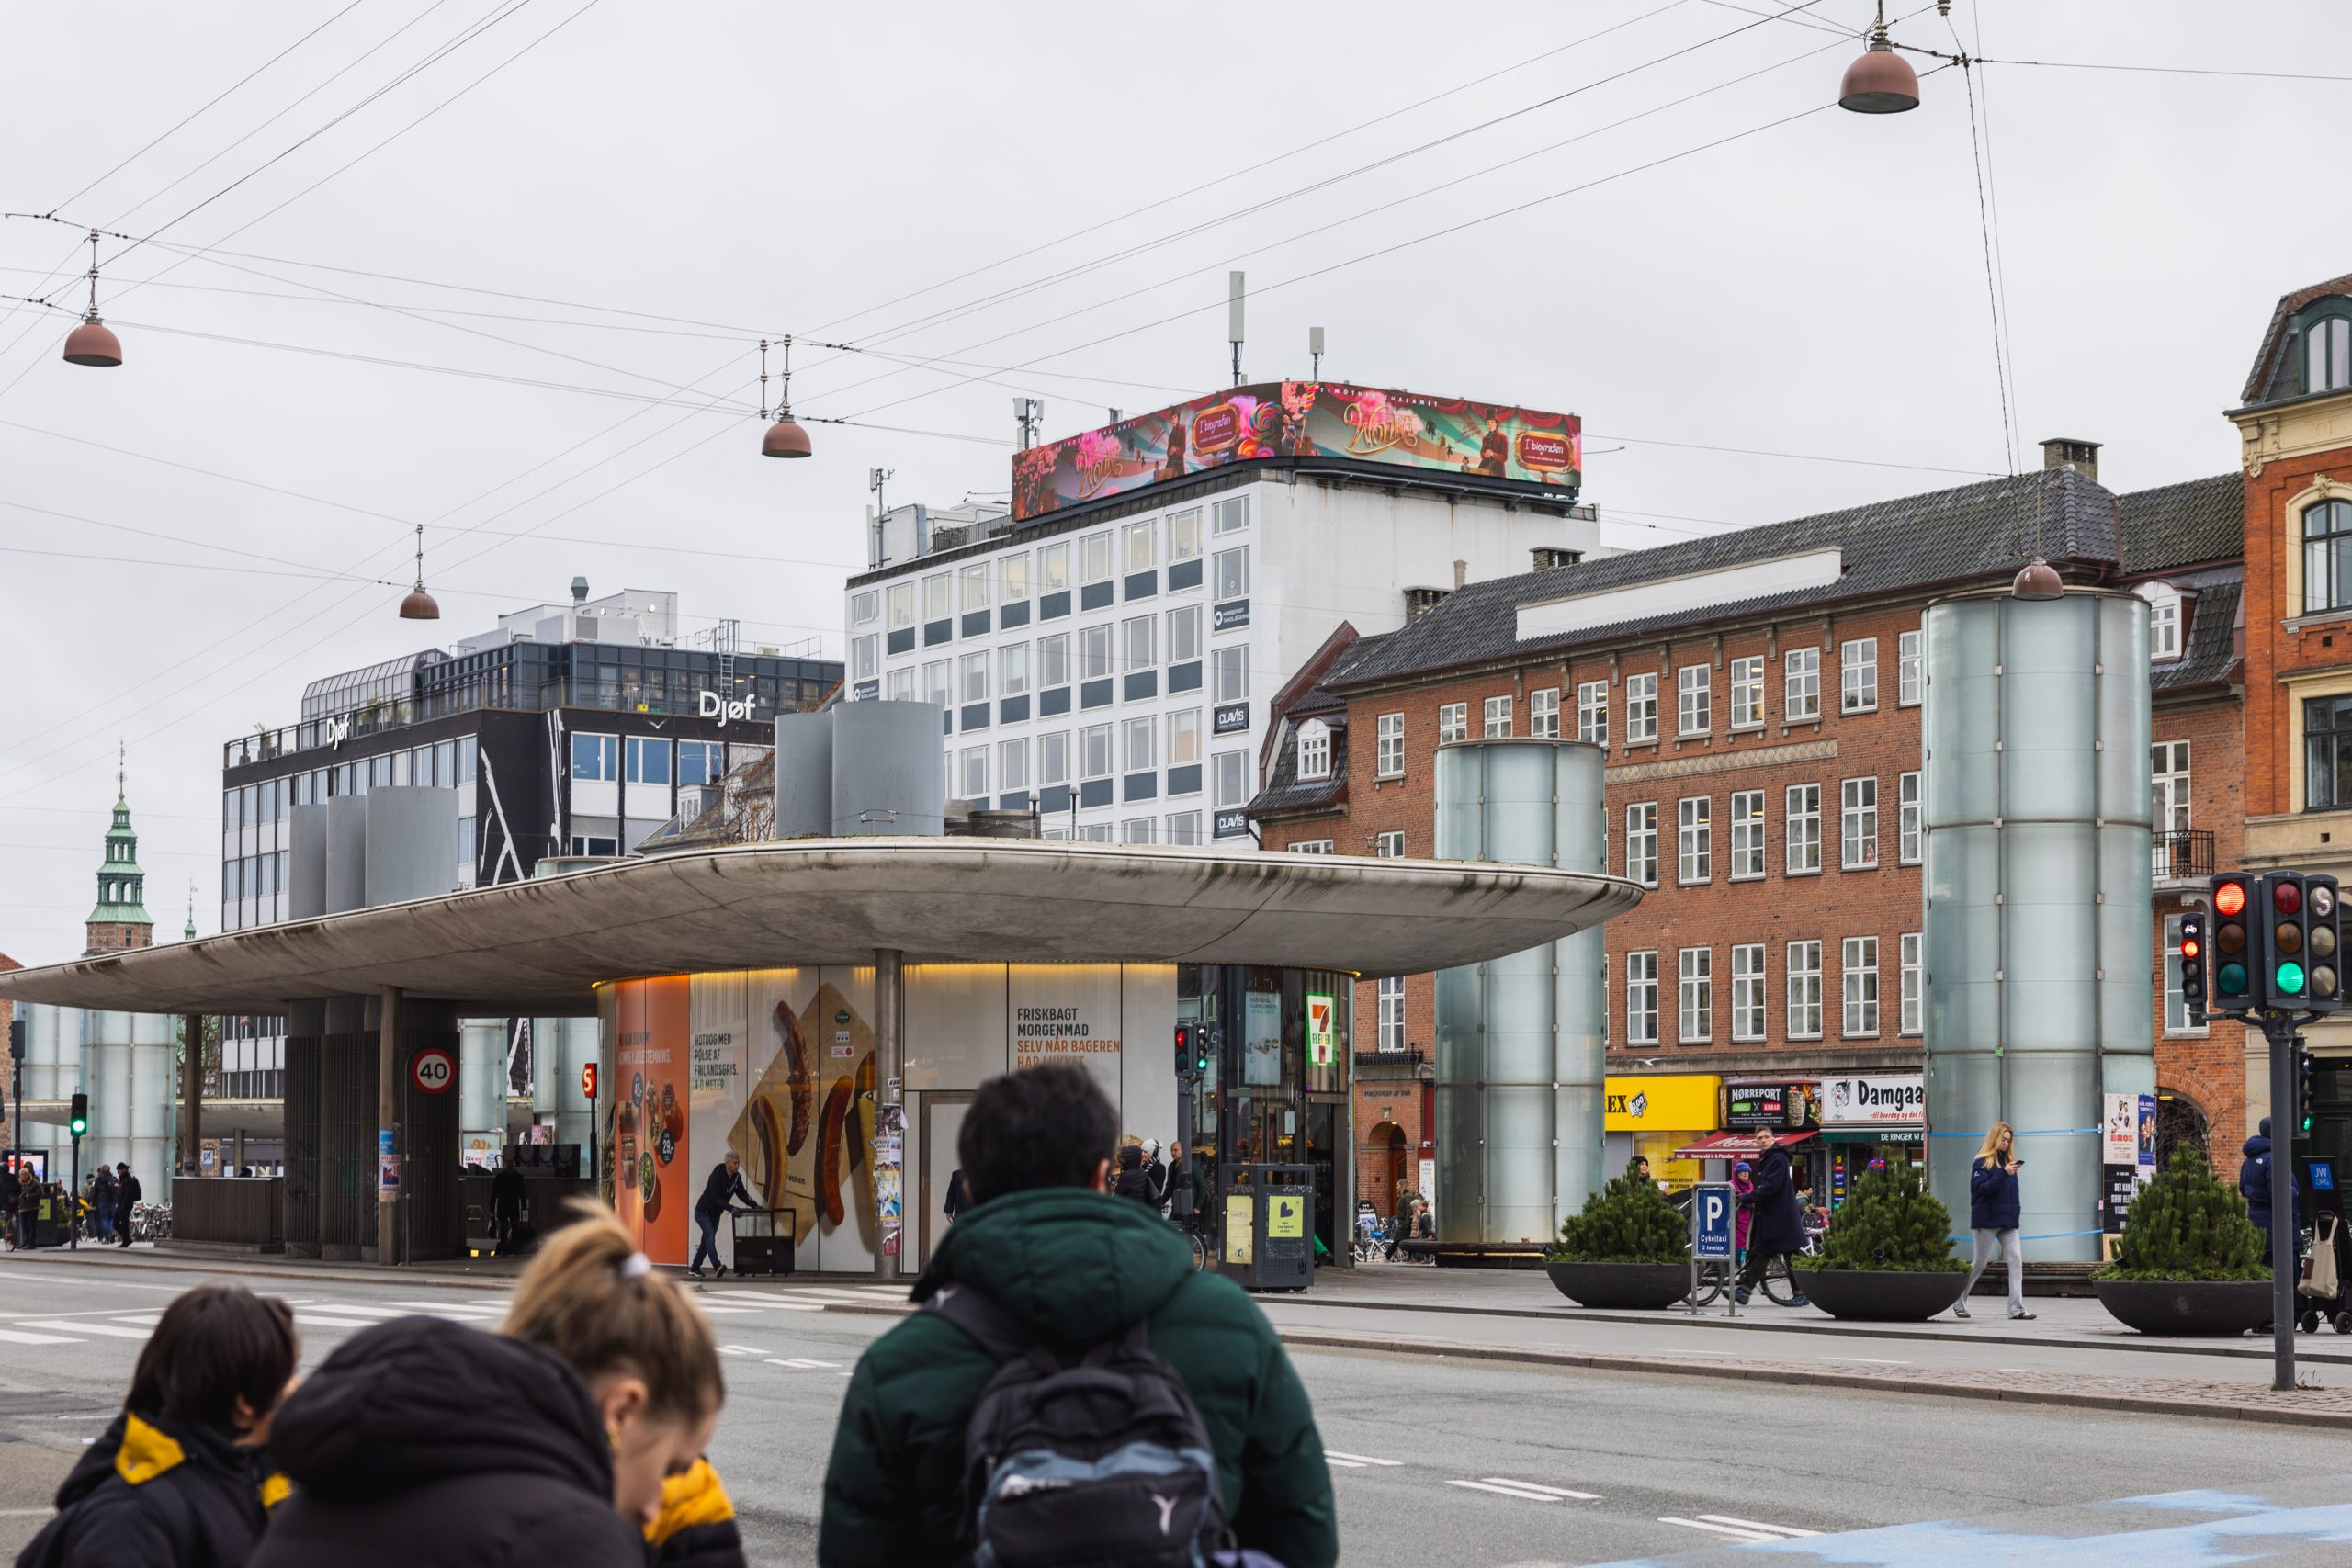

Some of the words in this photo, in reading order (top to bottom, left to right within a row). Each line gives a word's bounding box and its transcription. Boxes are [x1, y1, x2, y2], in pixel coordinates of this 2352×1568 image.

[1385, 394, 1438, 407] CHALAMET
[1343, 402, 1418, 456] Wonka
[1531, 439, 1565, 456] biografen
[699, 690, 756, 728] Djøf
[1219, 707, 1244, 725] CLAVIS
[326, 713, 350, 750] Djøf
[1219, 813, 1244, 829] CLAVIS
[1017, 1008, 1079, 1021] FRISKBAGT
[1017, 1023, 1089, 1036] MORGENMAD
[695, 1034, 718, 1046] HOTDOG
[718, 1033, 732, 1045] MED
[1017, 1040, 1043, 1053] SELV
[1046, 1036, 1068, 1053] NÅR
[1071, 1040, 1120, 1053] BAGEREN
[695, 1047, 712, 1062] PØLSE
[713, 1049, 721, 1061] AF
[418, 1062, 447, 1081] 40
[695, 1063, 739, 1076] FRILANDSGRIS.
[583, 1068, 593, 1092] S
[1732, 1088, 1781, 1102] NØRREPORT
[1605, 1095, 1627, 1113] EX
[1881, 1133, 1889, 1141] DE
[1890, 1133, 1912, 1141] RINGER
[1913, 1133, 1920, 1141] VI
[2110, 1134, 2133, 1142] BROS
[2315, 1168, 2327, 1178] JW
[1706, 1196, 1723, 1232] P
[1701, 1235, 1727, 1244] Cykeltaxi
